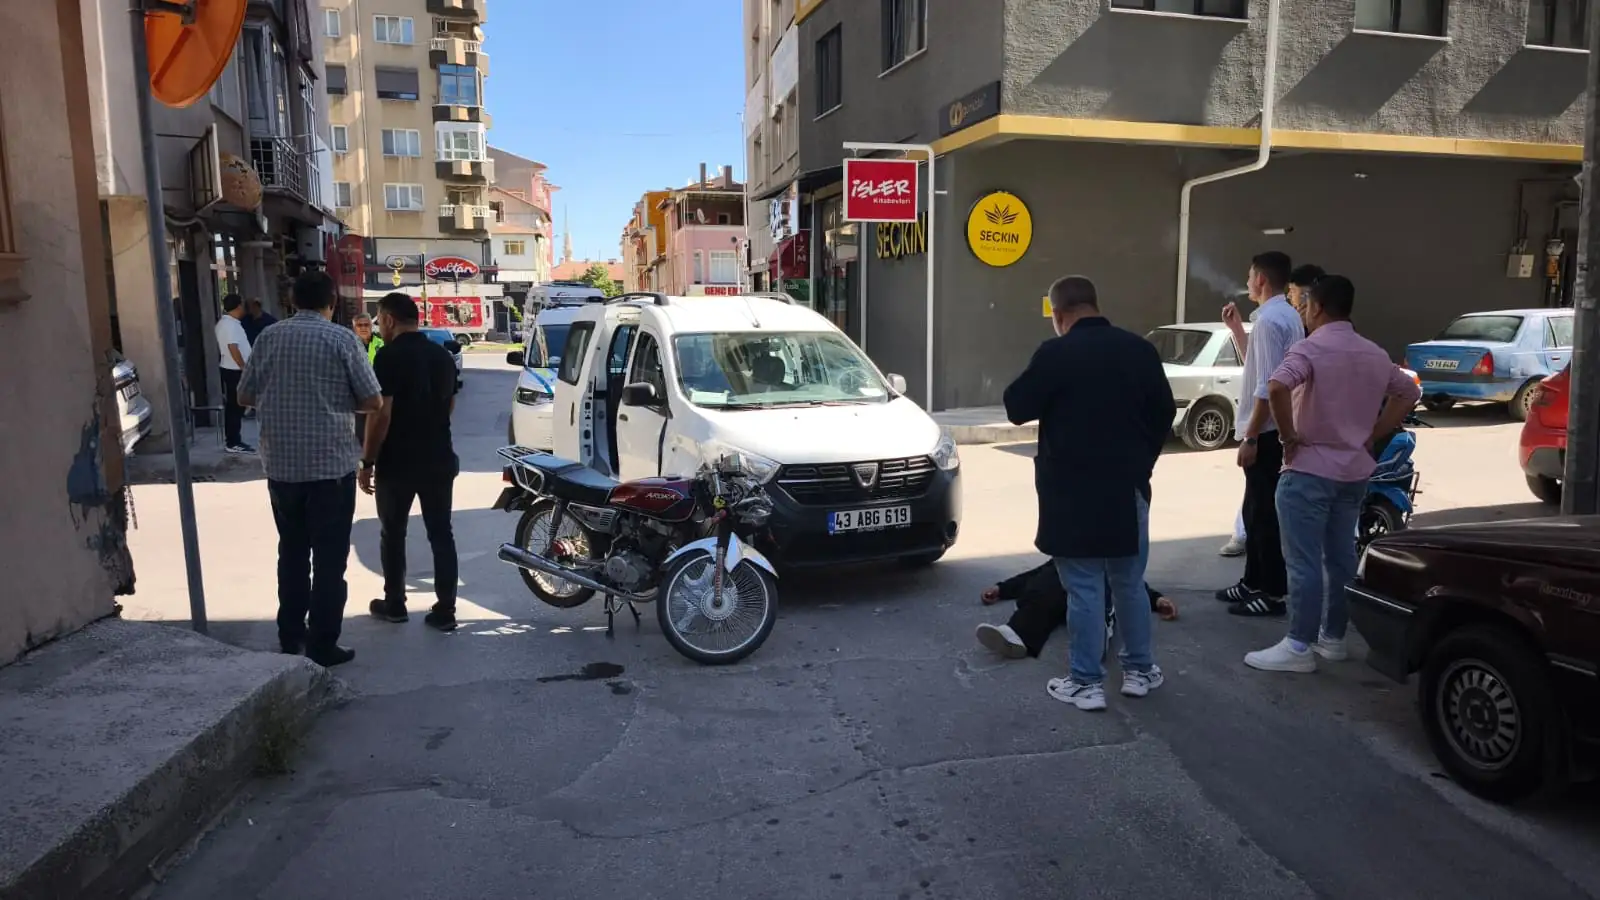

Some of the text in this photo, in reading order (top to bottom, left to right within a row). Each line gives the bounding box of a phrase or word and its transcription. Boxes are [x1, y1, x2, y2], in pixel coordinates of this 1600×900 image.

[835, 512, 851, 529] 43
[857, 510, 880, 527] ABG
[885, 507, 907, 523] 619
